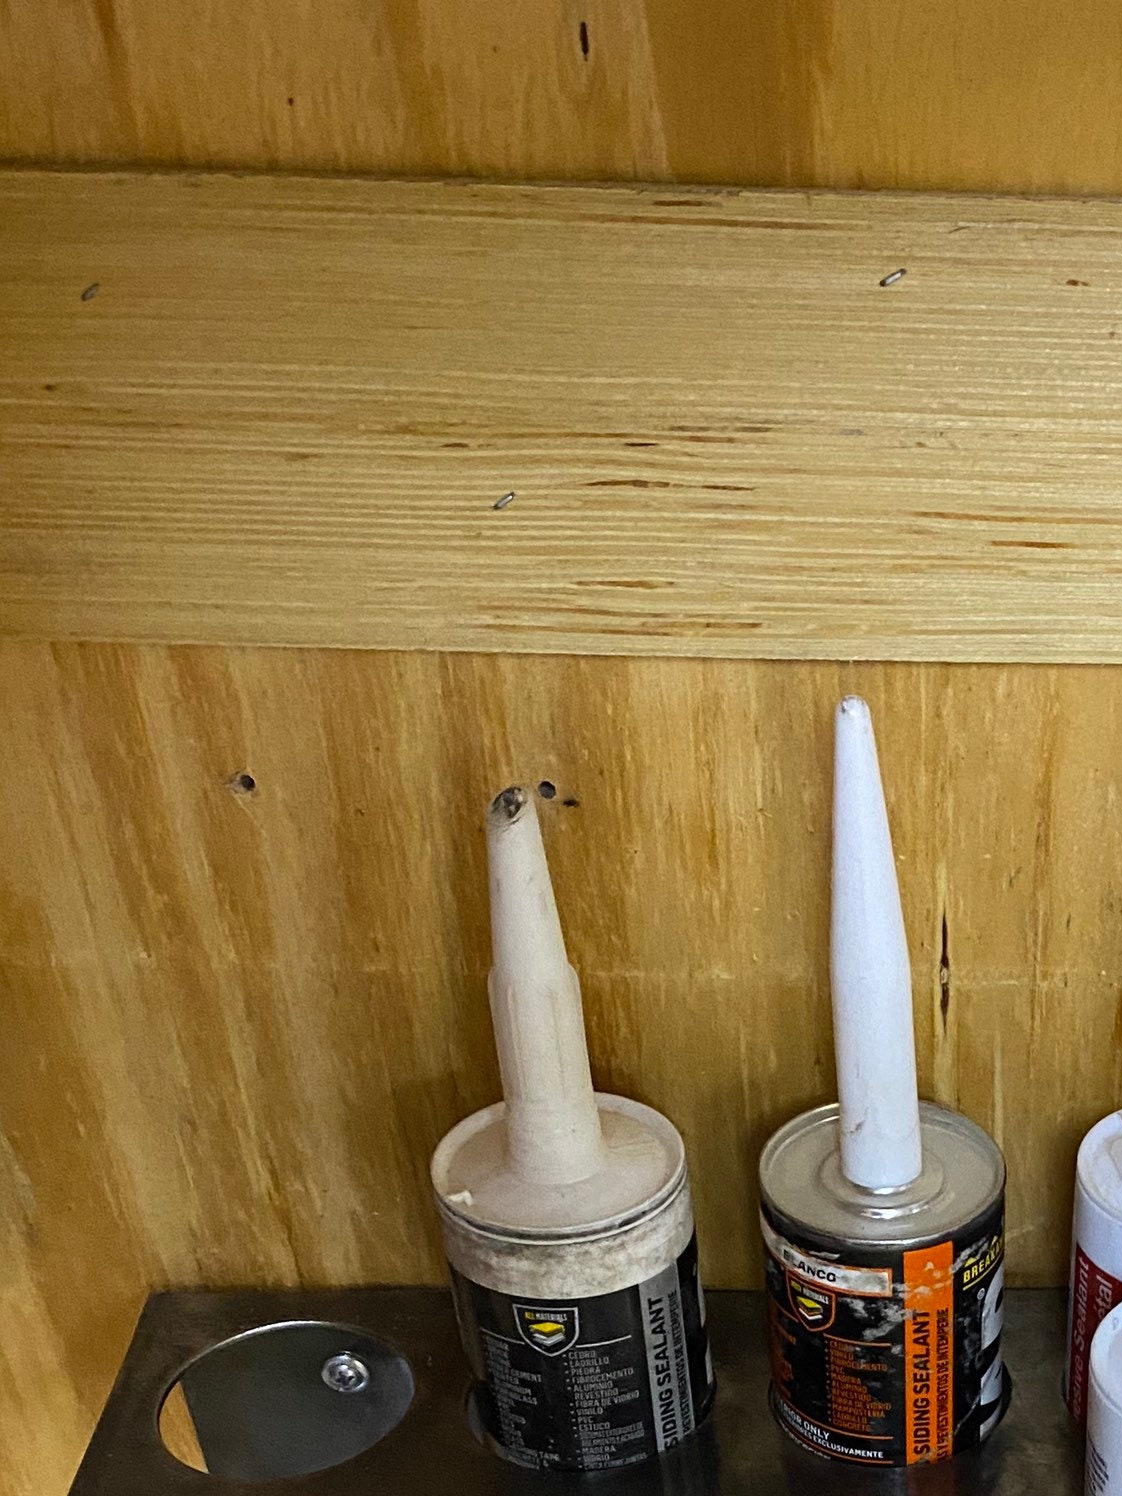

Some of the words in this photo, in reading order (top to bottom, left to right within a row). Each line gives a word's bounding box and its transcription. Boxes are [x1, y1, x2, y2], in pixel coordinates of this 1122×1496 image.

[783, 1249, 837, 1283] BANCO
[1073, 1256, 1090, 1352] Sealant
[570, 1366, 601, 1376] PIEDRA
[647, 1298, 672, 1388] SEALANT
[912, 1308, 931, 1395] SEALANT
[658, 1387, 681, 1450] SIDING
[803, 1421, 830, 1440] ONLY
[812, 1435, 884, 1459] EXCLUSIVAMENTE
[913, 1397, 931, 1456] SIDING
